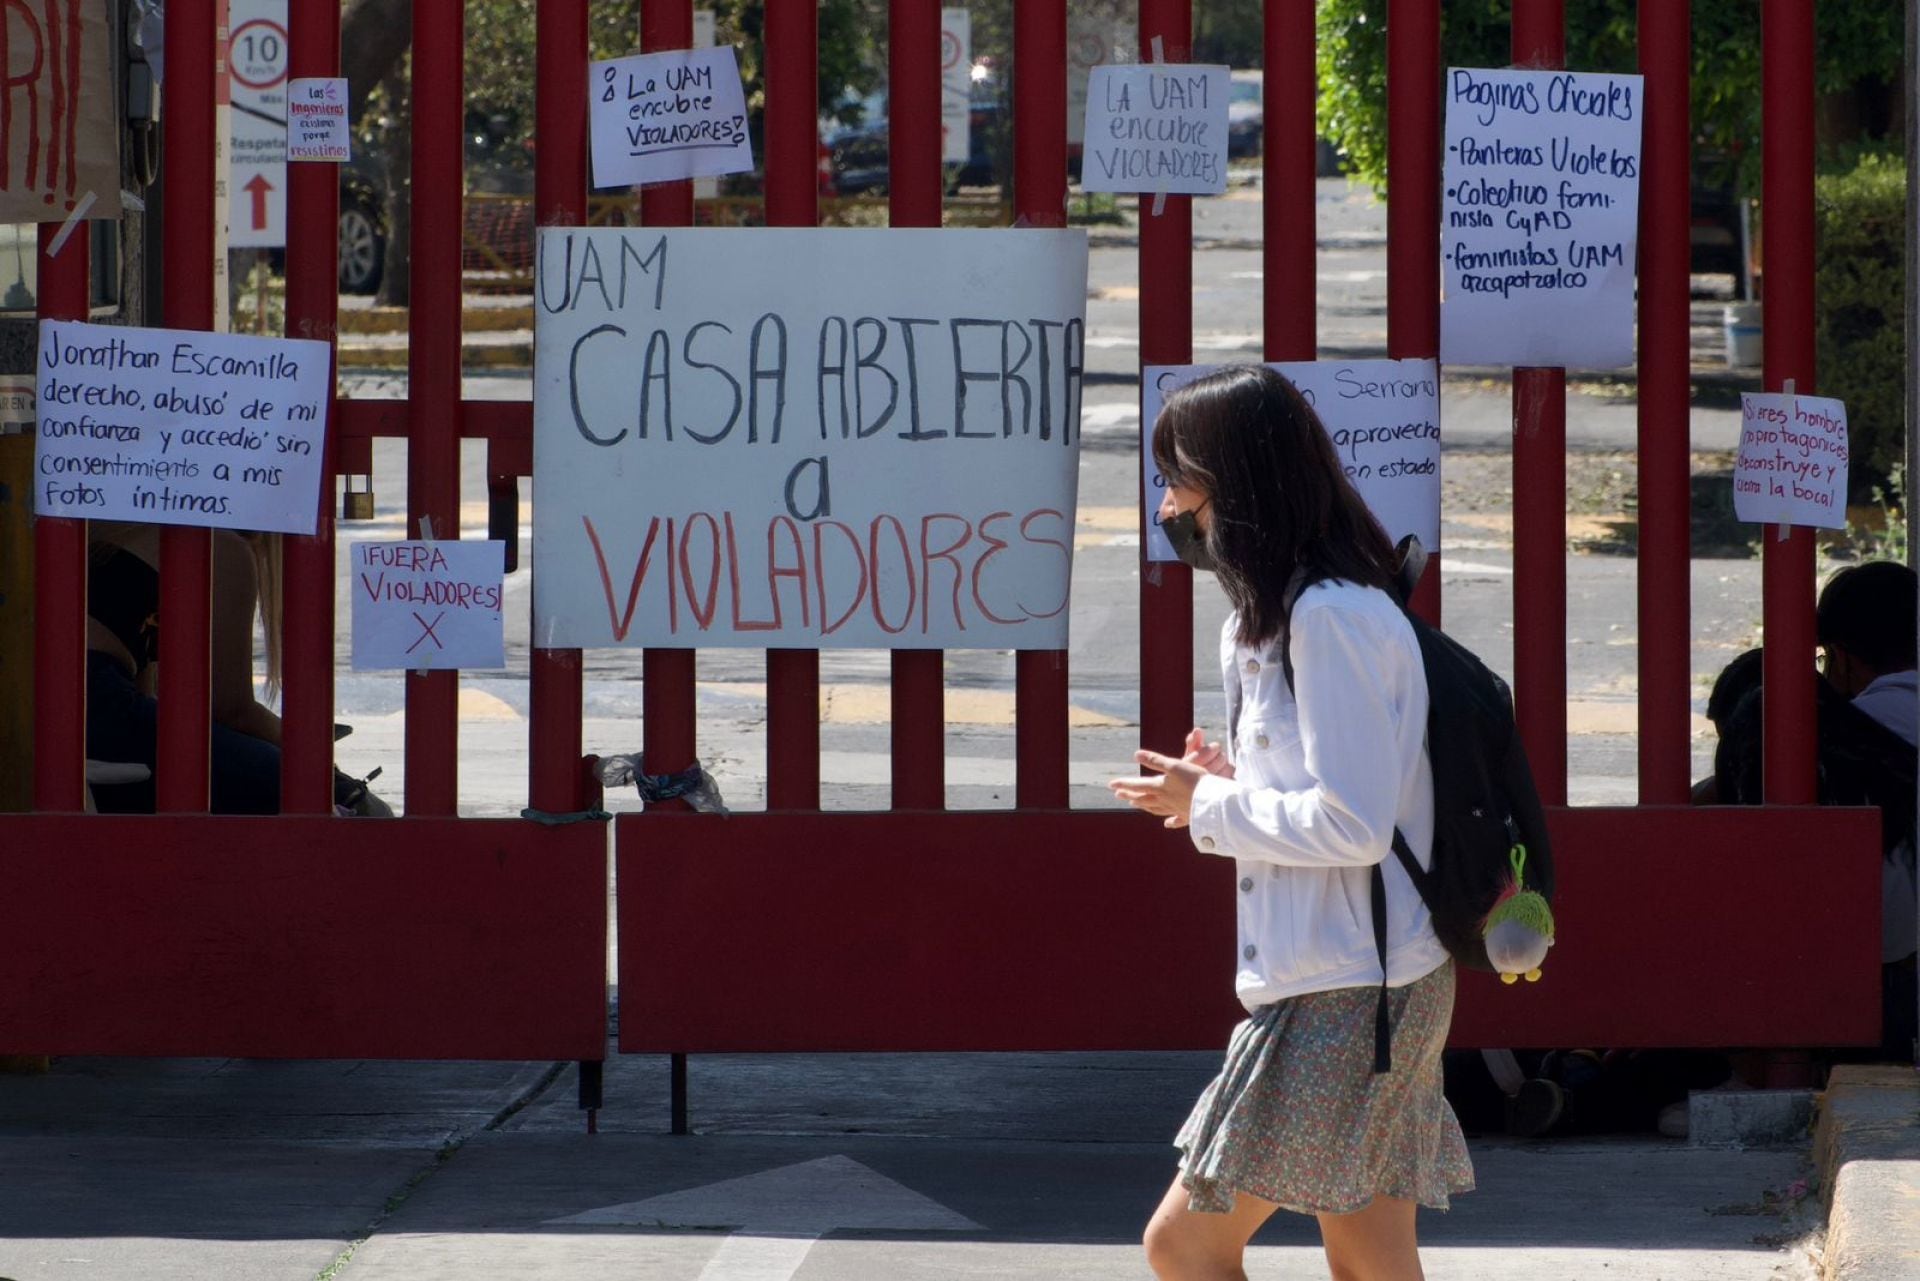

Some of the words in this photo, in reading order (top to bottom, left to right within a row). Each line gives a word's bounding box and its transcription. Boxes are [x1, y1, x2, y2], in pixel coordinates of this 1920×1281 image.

[243, 35, 278, 62] 10
[666, 66, 713, 91] UAM
[1106, 75, 1130, 113] LA
[1150, 74, 1208, 111] UAM
[629, 94, 712, 120] encubre
[1453, 70, 1540, 126] Paginas
[1548, 74, 1633, 121] Oficiales
[1109, 115, 1208, 147] encubre
[1096, 147, 1218, 184] VIOLADORES
[1460, 137, 1544, 166] Panteras
[1552, 136, 1637, 178] Violetas
[1451, 209, 1494, 228] nista
[1506, 210, 1572, 237] CyAD
[1454, 241, 1559, 270] feministas
[1569, 240, 1623, 269] UAM
[541, 234, 668, 313] UAM
[44, 330, 160, 370] Jonathan
[172, 343, 299, 381] Escamilla
[569, 312, 787, 446] CASA
[817, 315, 1085, 446] ABIERTA
[1334, 369, 1435, 399] Serrano
[44, 378, 145, 411] derecho,
[153, 387, 228, 416] abusó
[240, 399, 274, 421] de
[287, 401, 318, 421] mi
[1795, 401, 1845, 440] hombre
[160, 431, 172, 454] y
[181, 426, 270, 450] accedió
[277, 434, 311, 455] sin
[213, 463, 230, 482] a
[243, 465, 283, 486] mis
[1379, 457, 1436, 478] estado
[1827, 465, 1836, 484] y
[784, 455, 831, 521] a
[1770, 476, 1785, 498] la
[582, 508, 1070, 643] VIOLADORES
